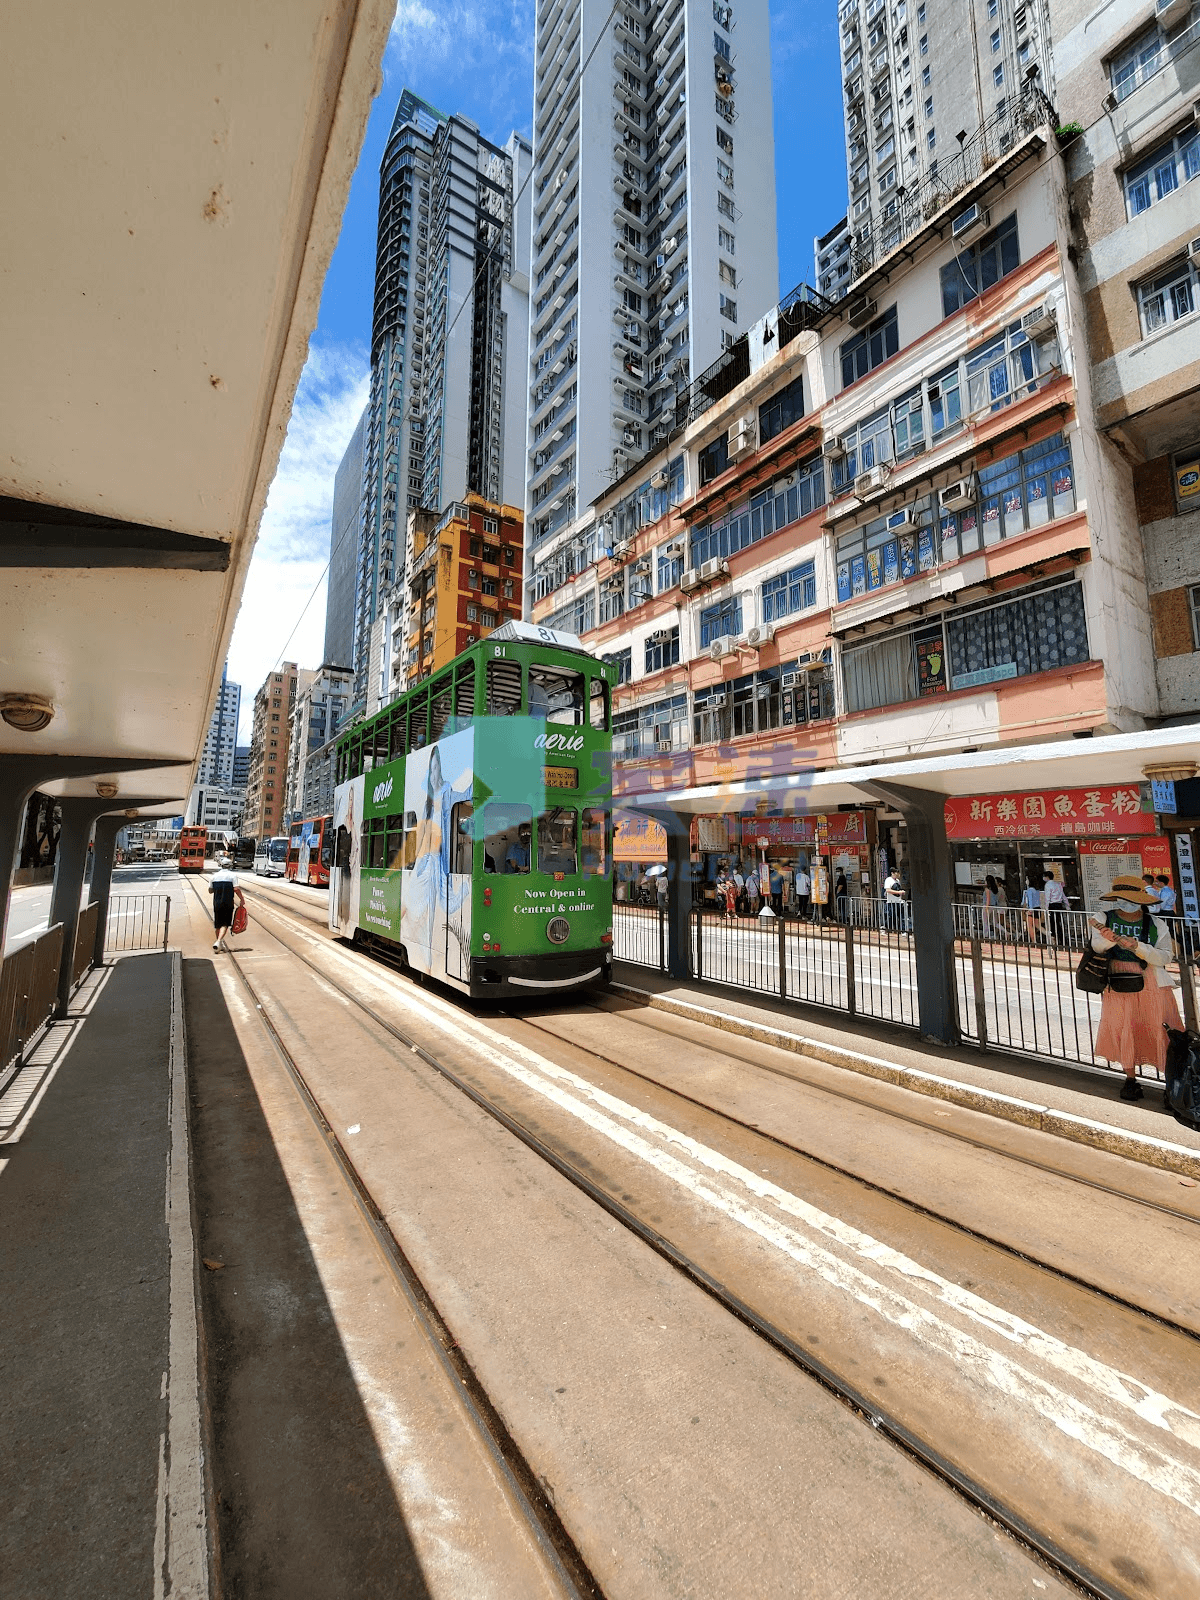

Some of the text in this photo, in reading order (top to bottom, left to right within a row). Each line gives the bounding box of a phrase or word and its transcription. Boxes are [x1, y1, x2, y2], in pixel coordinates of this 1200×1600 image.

[537, 627, 558, 643] 81
[494, 645, 506, 658] 81
[534, 730, 584, 751] aerie
[970, 789, 1141, 823] 新樂園魚蛋粉
[993, 821, 1116, 836] 西冷紅茶 檀島咖啡
[1092, 840, 1125, 852] Coca-Cola
[524, 888, 586, 899] Now Open in
[513, 901, 595, 914] Central & online
[1112, 922, 1143, 937] FITC
